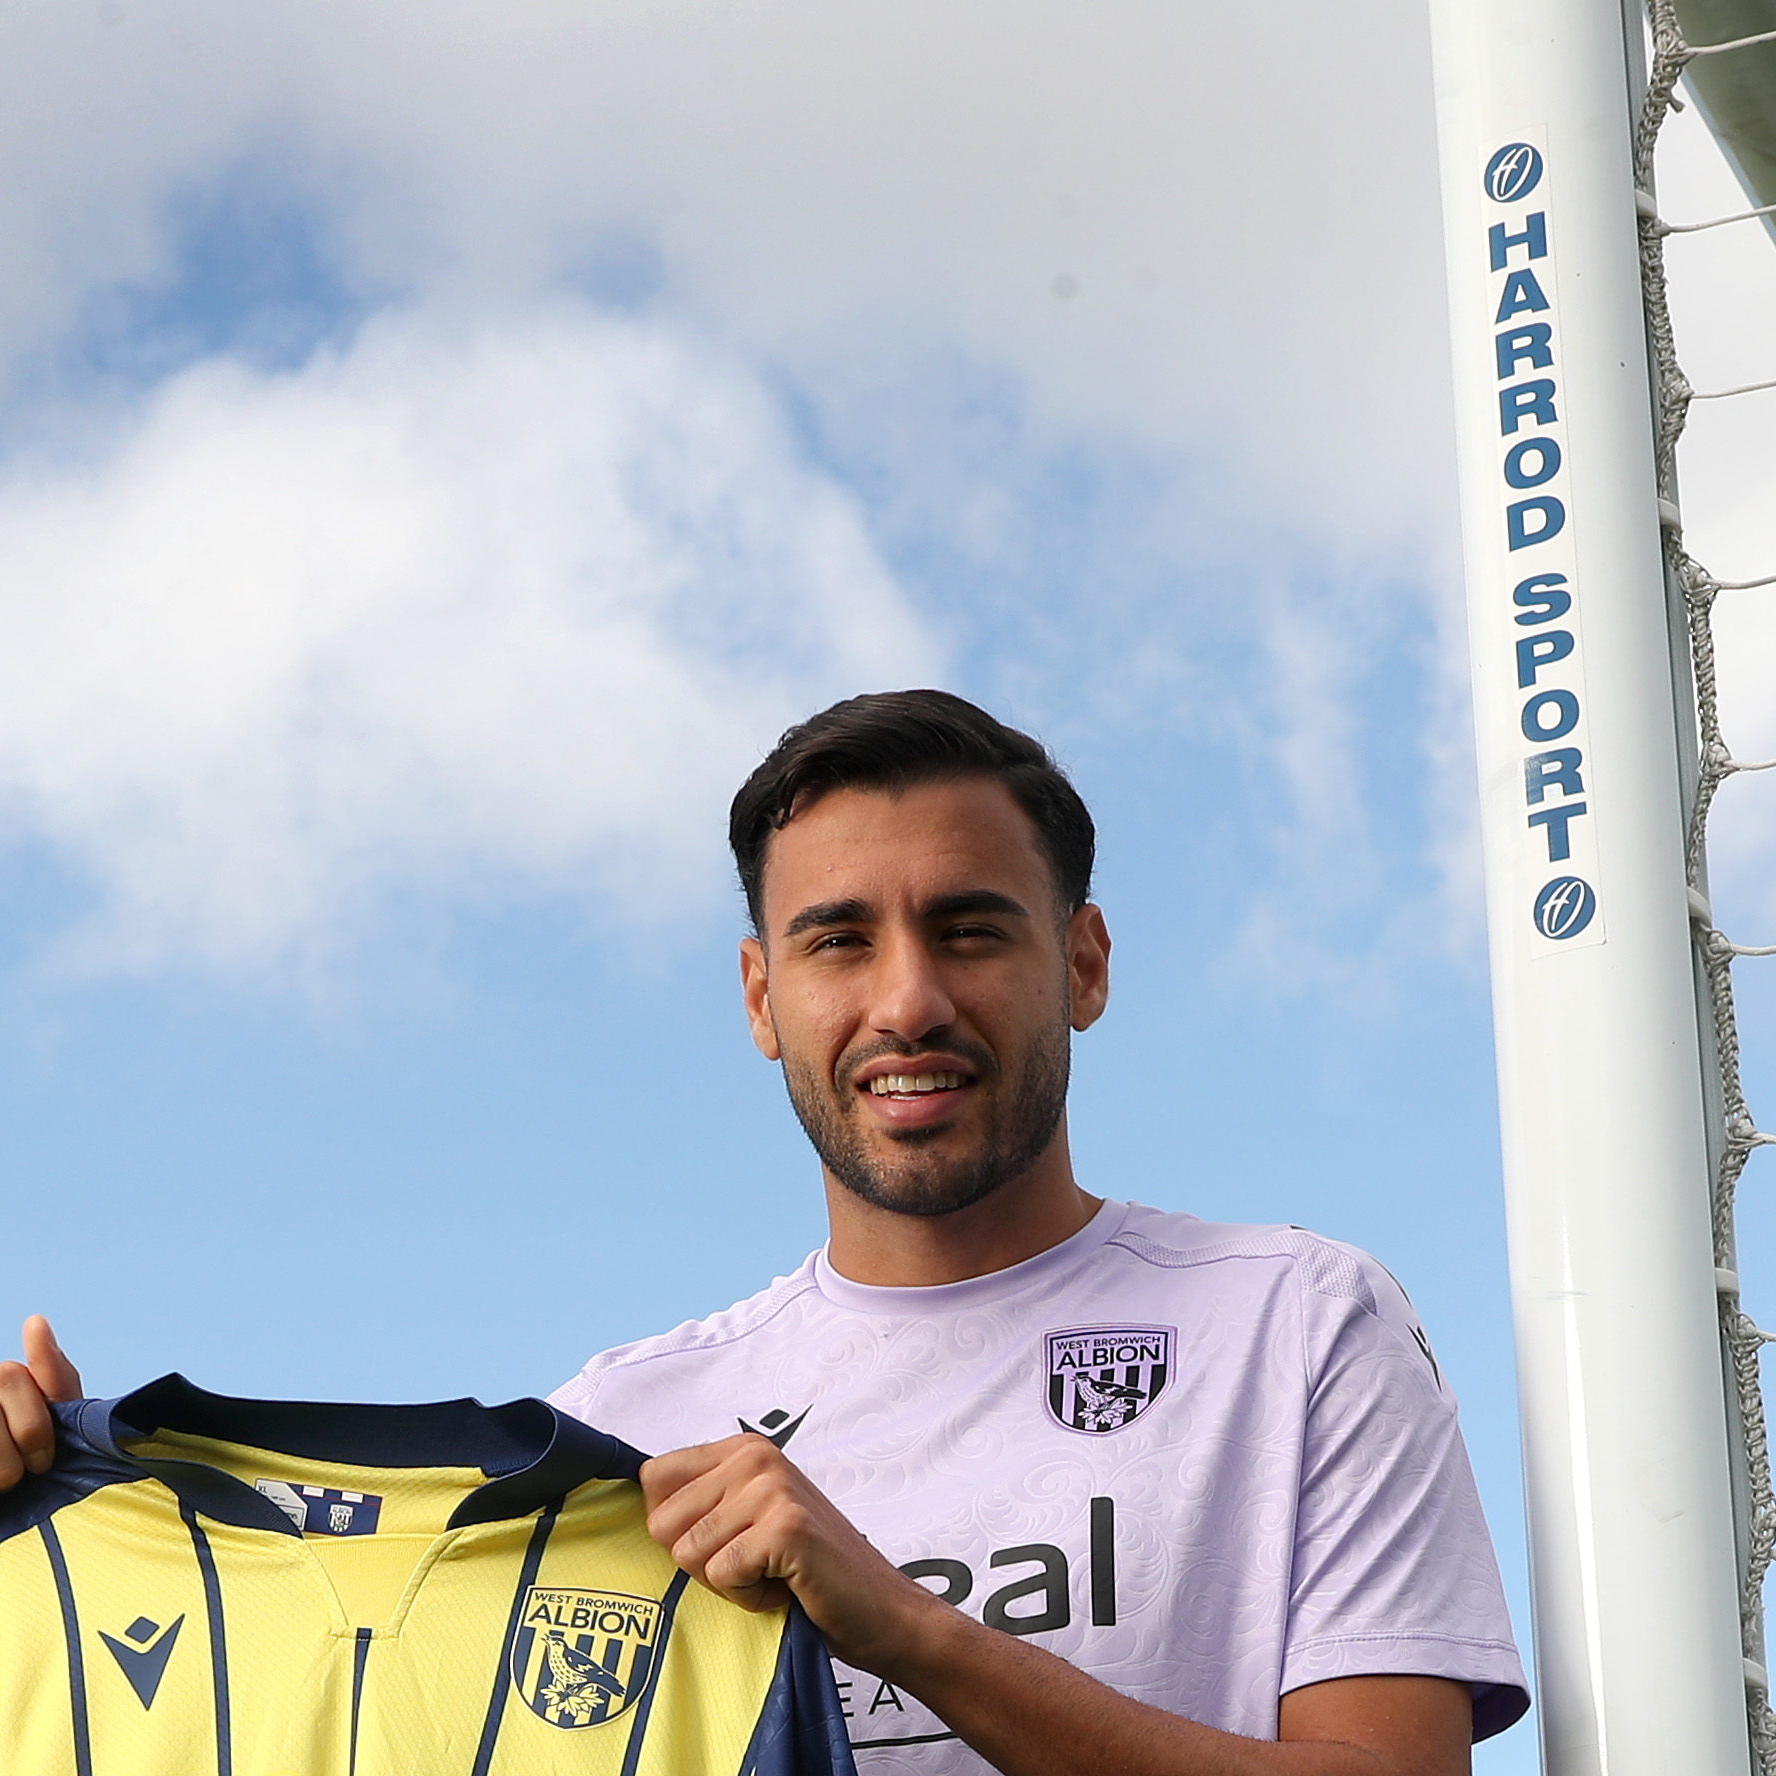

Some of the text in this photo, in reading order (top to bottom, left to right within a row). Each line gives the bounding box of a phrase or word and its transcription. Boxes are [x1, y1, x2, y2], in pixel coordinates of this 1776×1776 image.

[1488, 211, 1589, 863] HARROD SPORT
[1055, 1336, 1161, 1351] WEST BROMWICH
[1056, 1343, 1161, 1371] ALBION
[897, 1496, 1117, 1636] eal
[534, 1591, 655, 1617] WEST BROMWICH
[528, 1603, 652, 1640] ALBION
